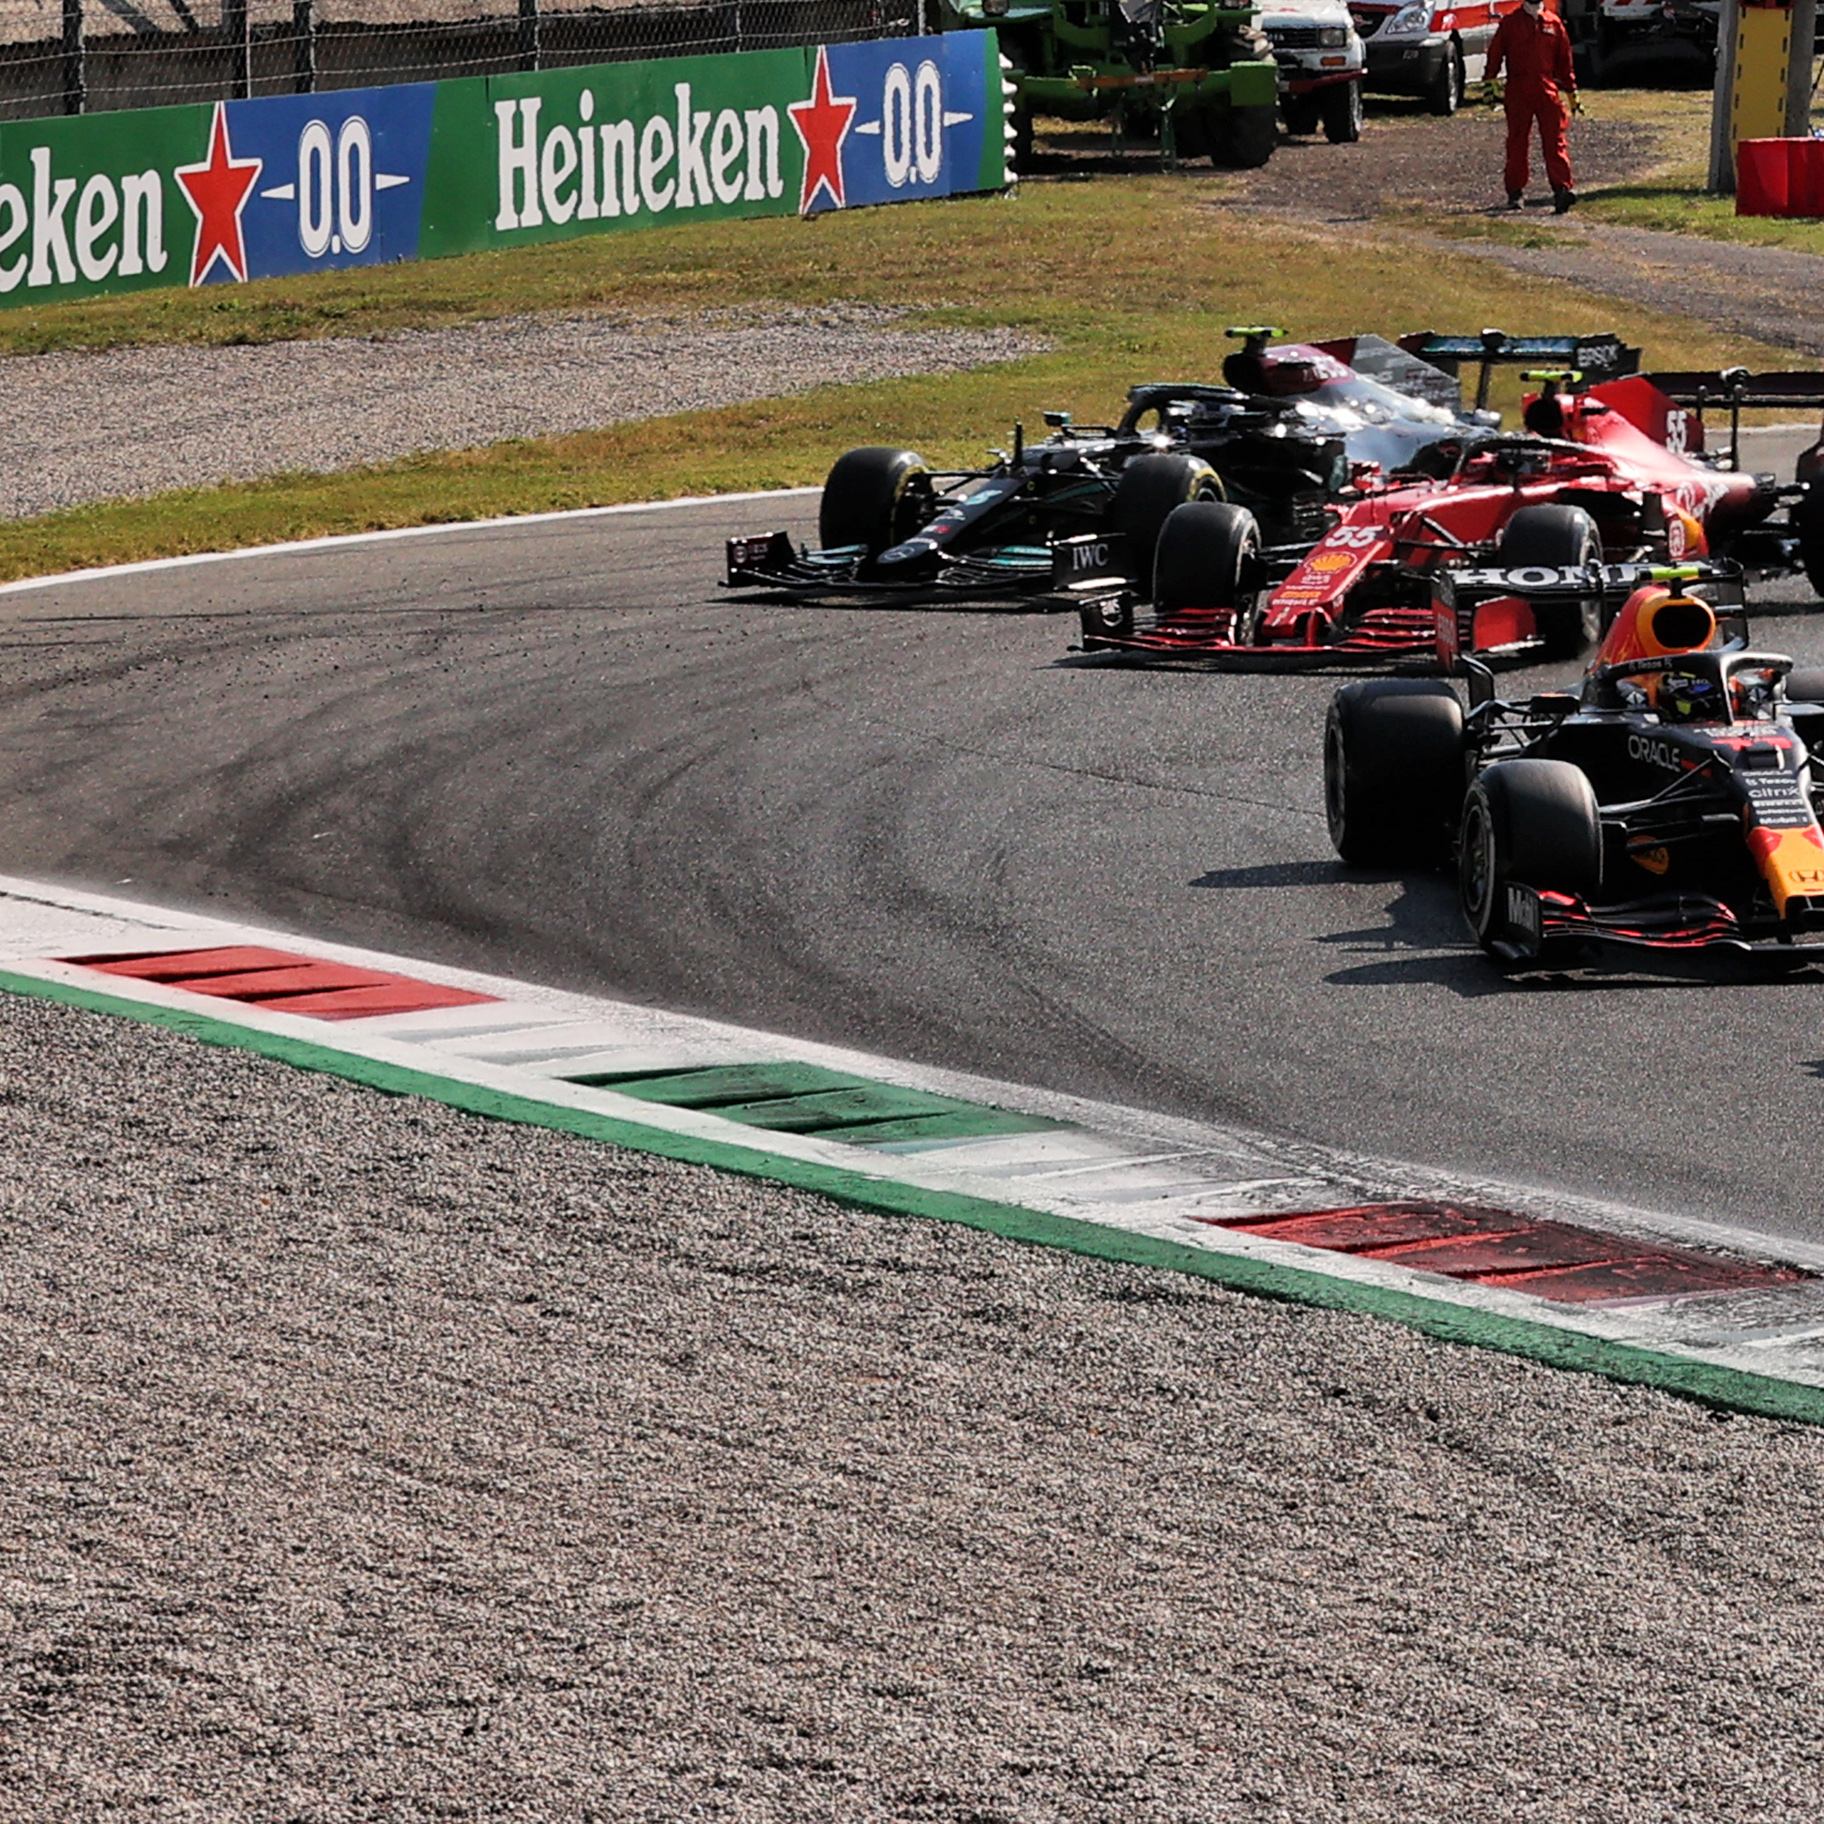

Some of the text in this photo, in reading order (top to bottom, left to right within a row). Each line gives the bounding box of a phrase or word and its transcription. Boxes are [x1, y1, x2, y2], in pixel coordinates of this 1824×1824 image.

[494, 58, 943, 231] Heineken 0.0
[299, 114, 372, 259] 0.0
[1665, 409, 1689, 455] 55
[1072, 542, 1110, 571] IWC
[1324, 525, 1384, 549] 55
[1627, 734, 1681, 773] ORACLE
